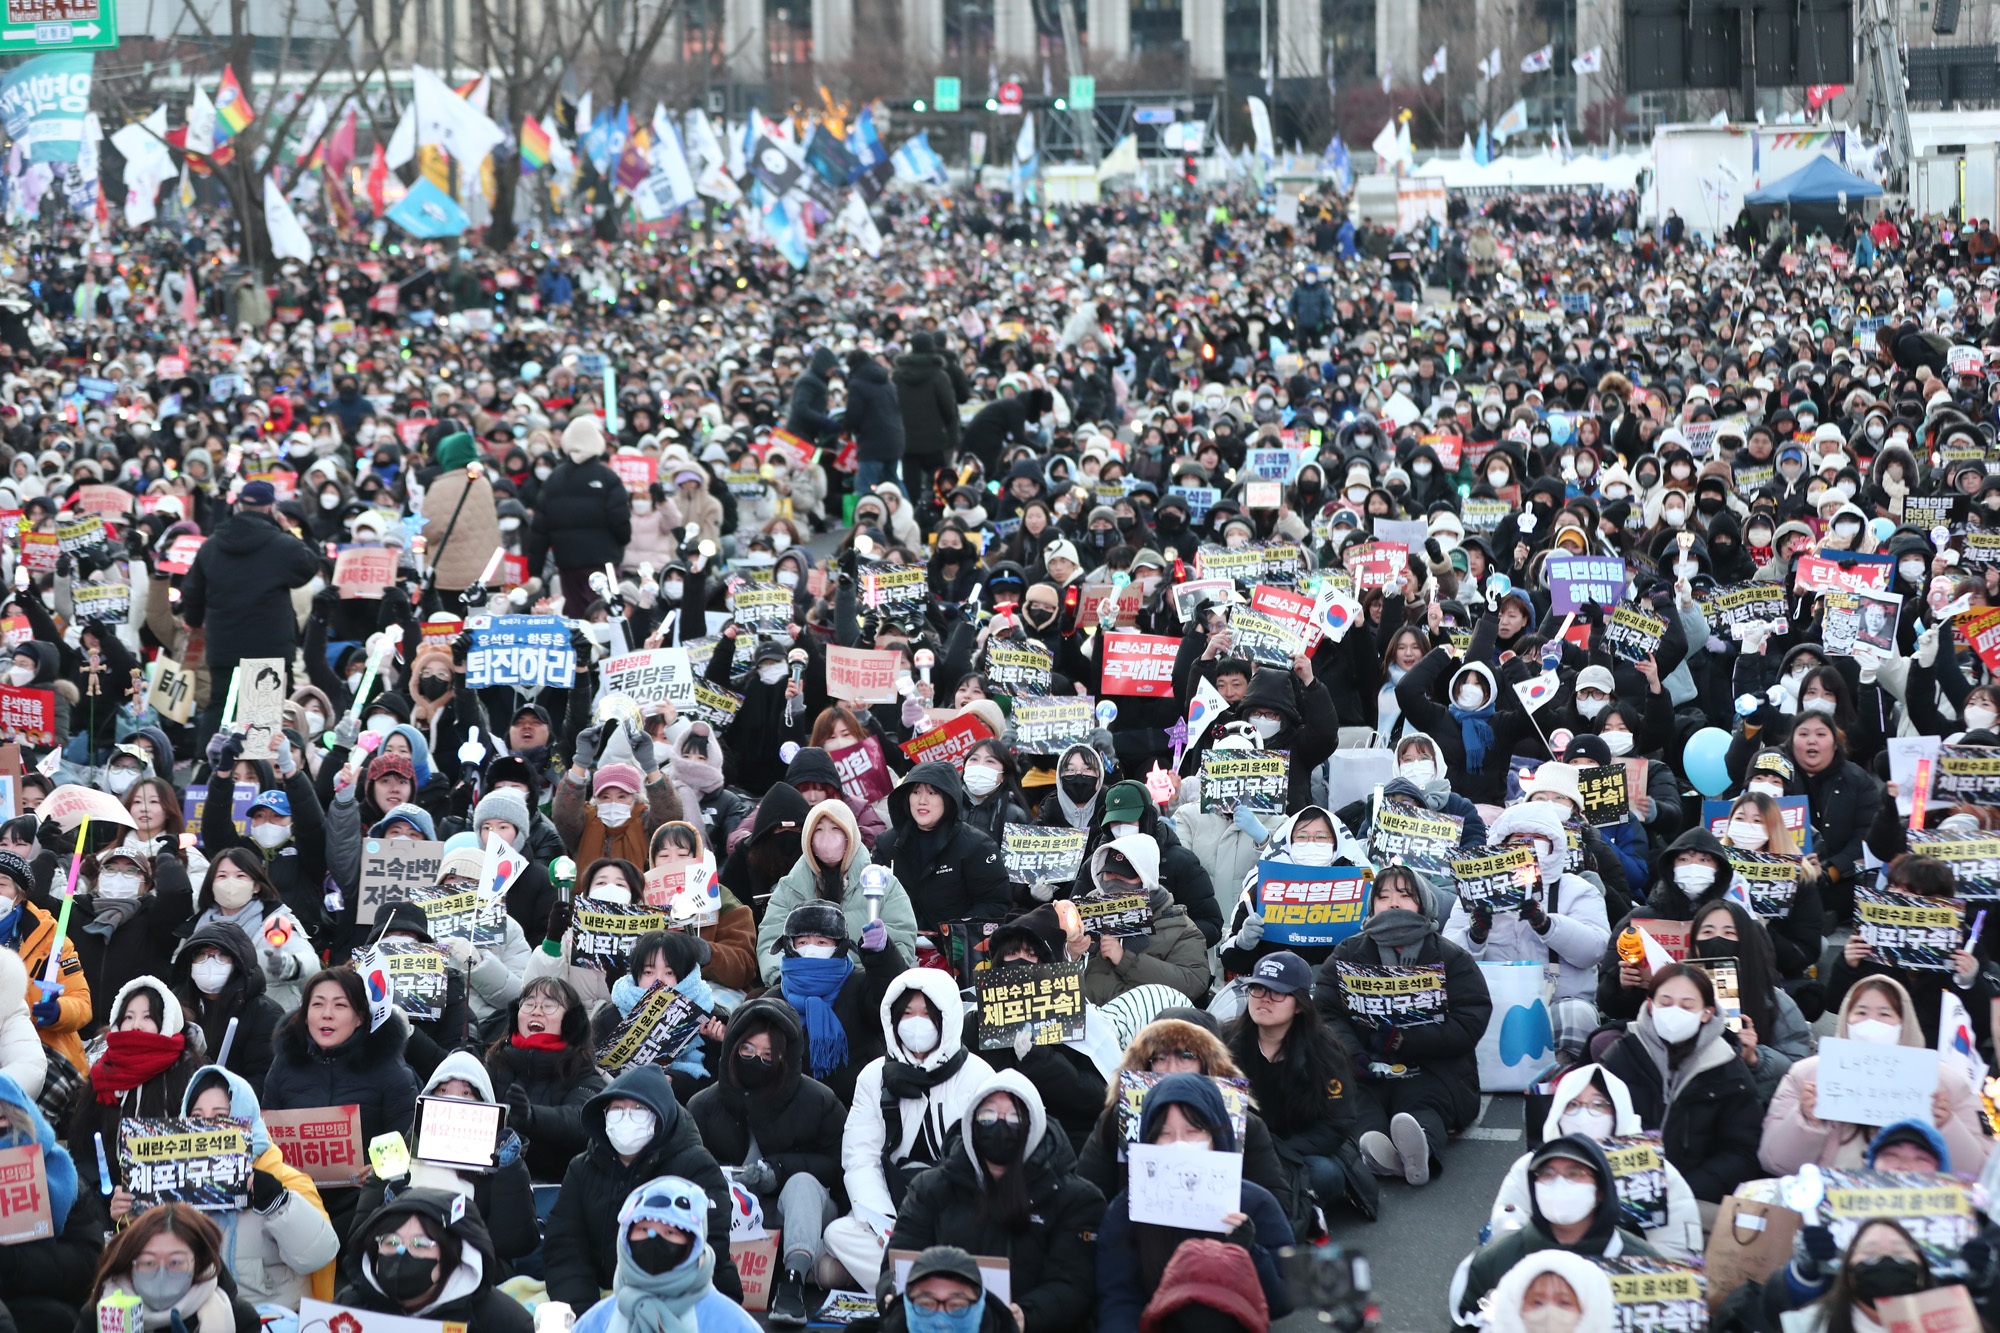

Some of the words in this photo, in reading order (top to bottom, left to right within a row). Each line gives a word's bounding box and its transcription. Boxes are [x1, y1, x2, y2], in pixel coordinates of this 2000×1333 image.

[11, 11, 43, 22] National
[46, 10, 62, 20] Folk
[66, 9, 98, 19] Museum
[1254, 453, 1290, 465] 윤석열
[1259, 467, 1287, 479] 체포!
[1906, 497, 1954, 509] 국힘의원
[1905, 509, 1946, 520] 85명은
[1206, 556, 1235, 566] 내란수괴
[1236, 553, 1257, 564] 윤석열
[897, 571, 919, 583] 윤석열
[1551, 561, 1623, 582] 국민의힘
[736, 592, 765, 607] 내란수괴
[766, 589, 788, 602] 윤석열
[1257, 593, 1299, 613] 내란수괴
[1570, 584, 1612, 605] 해체!
[1722, 592, 1754, 606] 내란수괴
[1755, 588, 1778, 600] 윤석열
[1236, 616, 1271, 632] 내란수괴
[1614, 609, 1638, 626] 내란수괴
[1638, 617, 1661, 634] 윤석열
[478, 634, 515, 647] 윤석열
[527, 633, 565, 646] 한동훈
[1108, 641, 1153, 656] 내란수괴
[467, 648, 576, 687] 퇴진하라
[605, 654, 652, 674] 내란정범
[831, 655, 860, 667] 내란동조
[863, 660, 893, 670] 국민의힘
[995, 652, 1028, 665] 내란수괴
[1029, 656, 1049, 669] 윤석열
[609, 664, 675, 693] 국힘당을
[830, 666, 894, 689] 해체하라
[1, 694, 43, 715] 윤석열을
[710, 693, 733, 711] 윤석열
[1, 711, 44, 732] 체포하라
[1021, 708, 1057, 722] 내란수괴
[1059, 706, 1086, 719] 윤석열
[907, 729, 948, 754] 윤석열을
[915, 729, 976, 763] 파면하고
[835, 747, 873, 782] 의힘
[1211, 762, 1250, 776] 내란수괴
[1252, 761, 1280, 773] 윤석열
[1948, 761, 1990, 773] 내란수괴
[1591, 774, 1623, 789] 윤석열
[1383, 815, 1420, 833] 내란수괴
[1421, 821, 1452, 838] 윤석열
[1013, 837, 1050, 850] 내란수괴
[1052, 836, 1079, 849] 윤석열
[1920, 844, 1963, 858] 내란수괴
[365, 858, 441, 884] 고속탄핵
[1456, 860, 1493, 879] 내란수괴
[1494, 851, 1527, 870] 윤석열
[1759, 865, 1791, 878] 윤석열
[1264, 880, 1363, 903] 윤석열을!
[425, 894, 463, 915] 내란수괴
[1110, 899, 1139, 914] 윤석열
[1264, 902, 1363, 925] 파면하라!
[584, 915, 626, 930] 내란수괴
[627, 916, 660, 929] 윤석열
[1866, 905, 1911, 921] 내란수괴
[1912, 910, 1952, 925] 윤석열
[1289, 934, 1307, 943] 민주당
[403, 958, 438, 971] 윤석열
[982, 982, 1036, 1003] 내란수괴
[1040, 974, 1080, 994] 윤석열
[1350, 978, 1395, 992] 내란수괴
[1397, 977, 1434, 990] 윤석열
[609, 1024, 646, 1067] 내란수괴
[640, 994, 669, 1027] 윤석열
[1035, 1033, 1064, 1046] 체포!
[458, 1108, 497, 1124] 조심하
[303, 1123, 348, 1137] 국민의힘
[137, 1140, 192, 1157] 내란수괴
[195, 1134, 237, 1152] 윤석열
[281, 1138, 356, 1169] 체하라
[1611, 1151, 1649, 1171] 윤석열
[1838, 1194, 1907, 1212] 내란수괴
[1909, 1193, 1958, 1210] 윤석열
[1642, 1278, 1690, 1295] 윤석열
